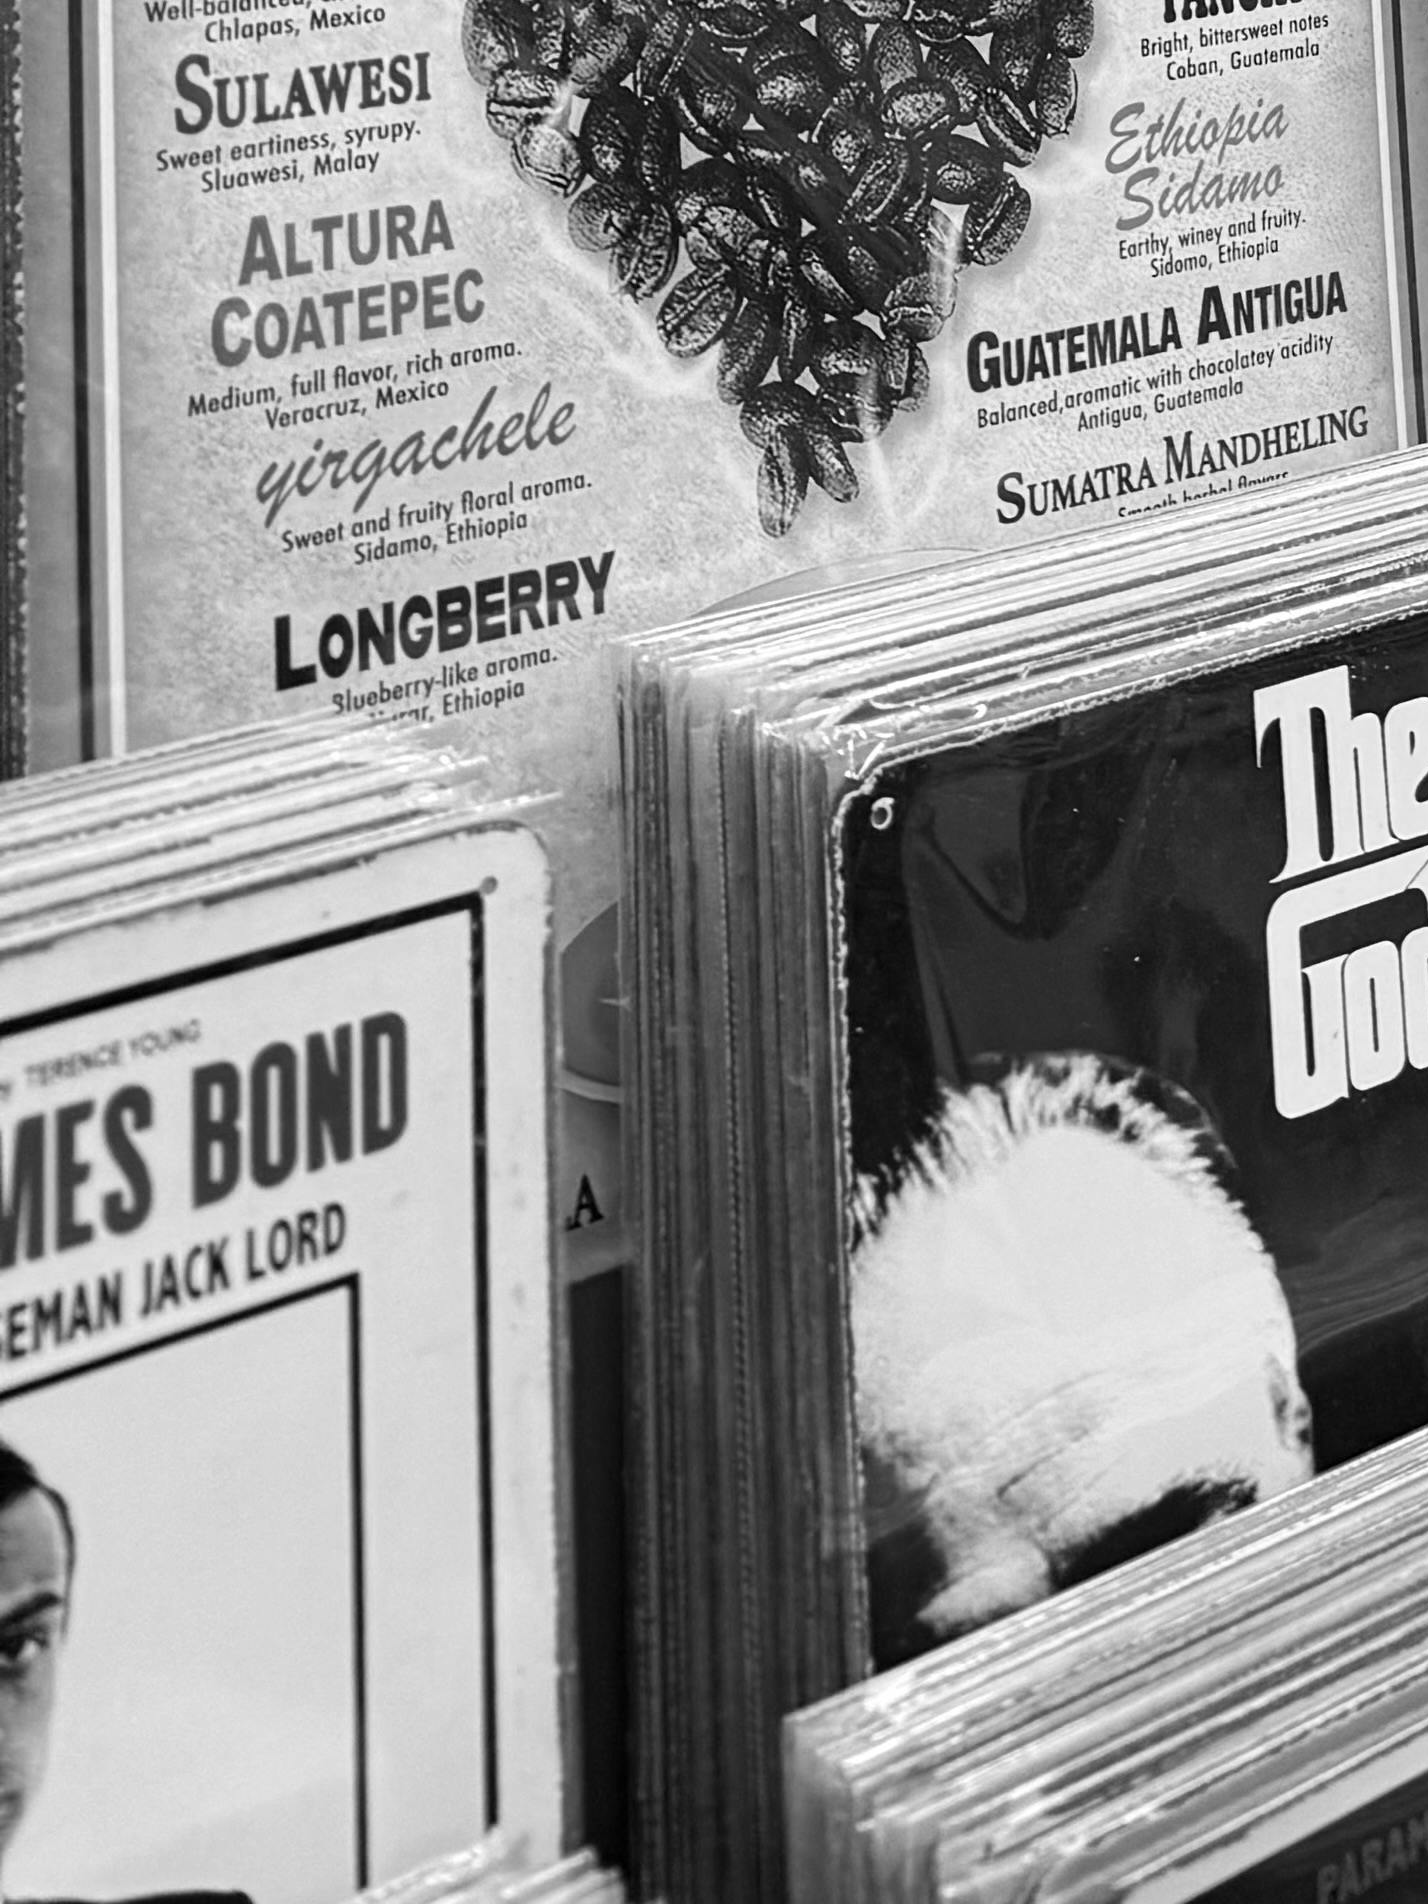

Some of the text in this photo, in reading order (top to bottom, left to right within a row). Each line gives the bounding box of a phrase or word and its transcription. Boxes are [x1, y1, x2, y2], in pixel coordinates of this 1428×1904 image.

[174, 50, 432, 136] SULAWESI
[967, 271, 1347, 394] GUATEMALA ANTIGUA
[255, 381, 577, 529] yirgachele
[996, 456, 1157, 525] SUMATRA
[1164, 405, 1369, 484] MANDHELING
[273, 551, 616, 693] LONGBERRY
[23, 1016, 202, 1089] TERENCE YOUNG
[189, 1010, 410, 1210] BOND
[139, 1200, 346, 1321] JACK LORD
